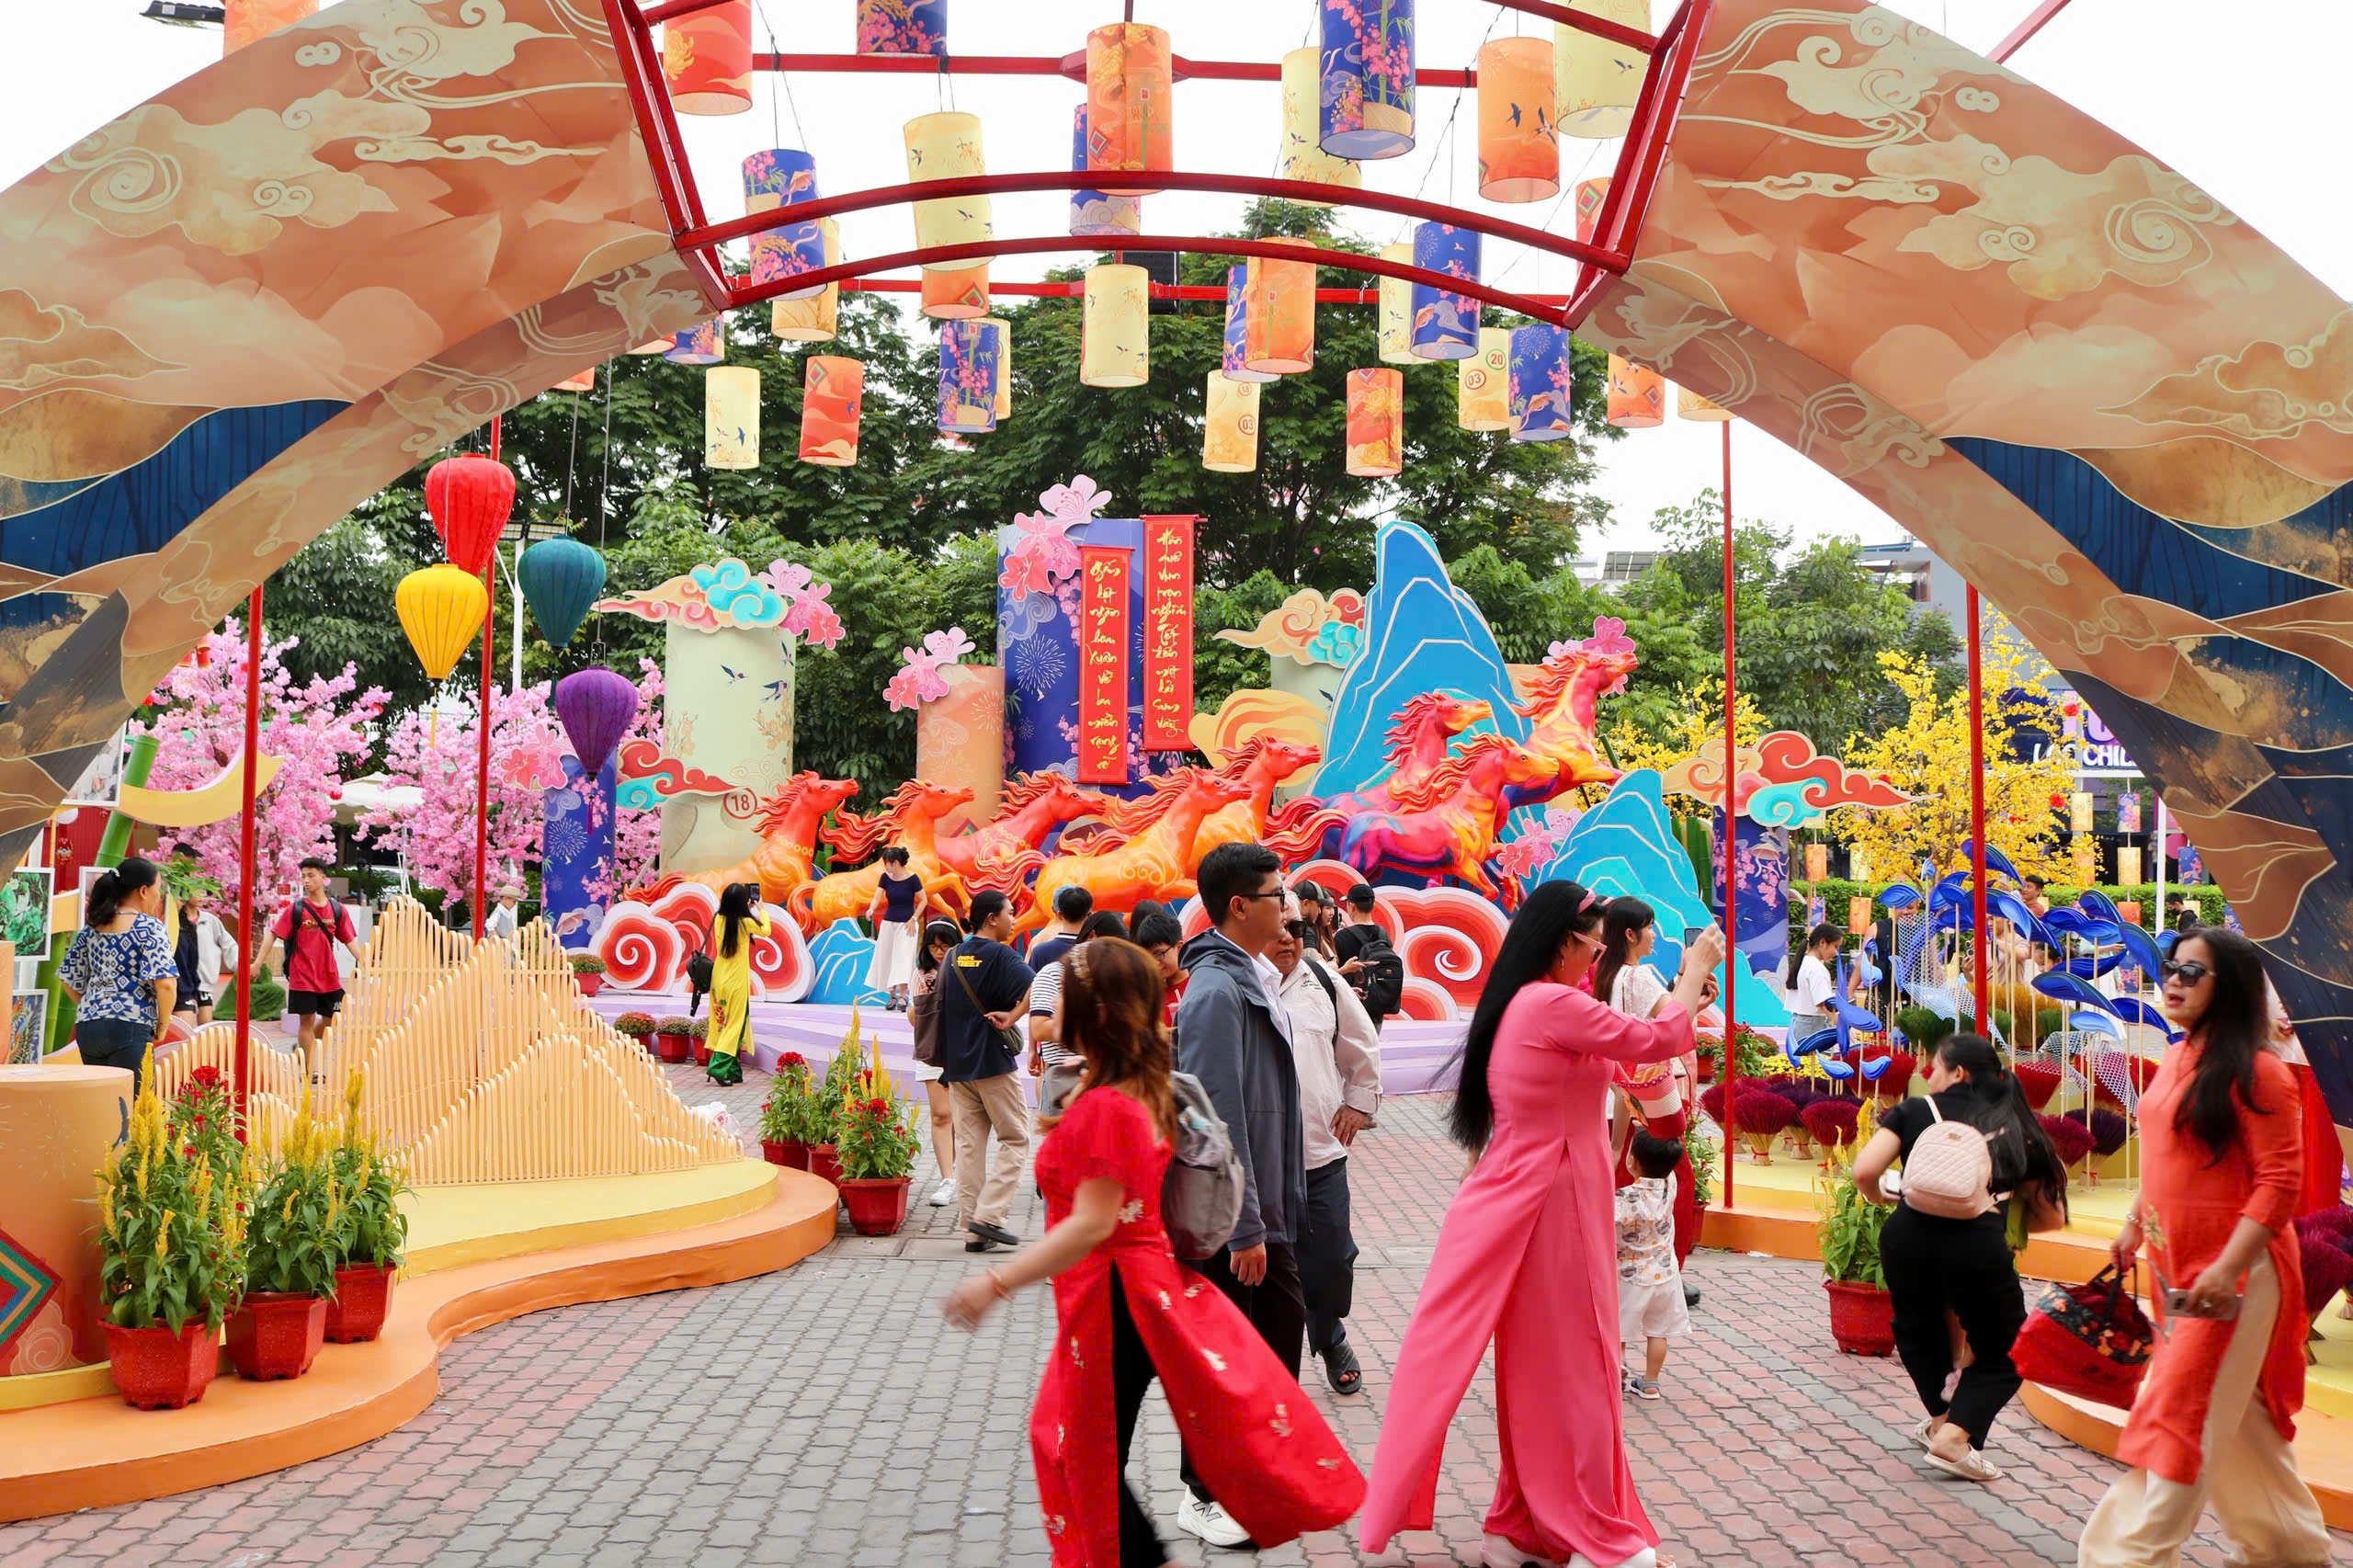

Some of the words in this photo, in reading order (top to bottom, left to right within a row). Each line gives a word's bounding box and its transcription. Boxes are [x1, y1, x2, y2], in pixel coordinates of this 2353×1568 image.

[1490, 353, 1504, 366] 20
[1468, 372, 1482, 386] 03
[1242, 418, 1254, 430] 03
[1097, 688, 1110, 705] ba
[731, 793, 750, 812] 18
